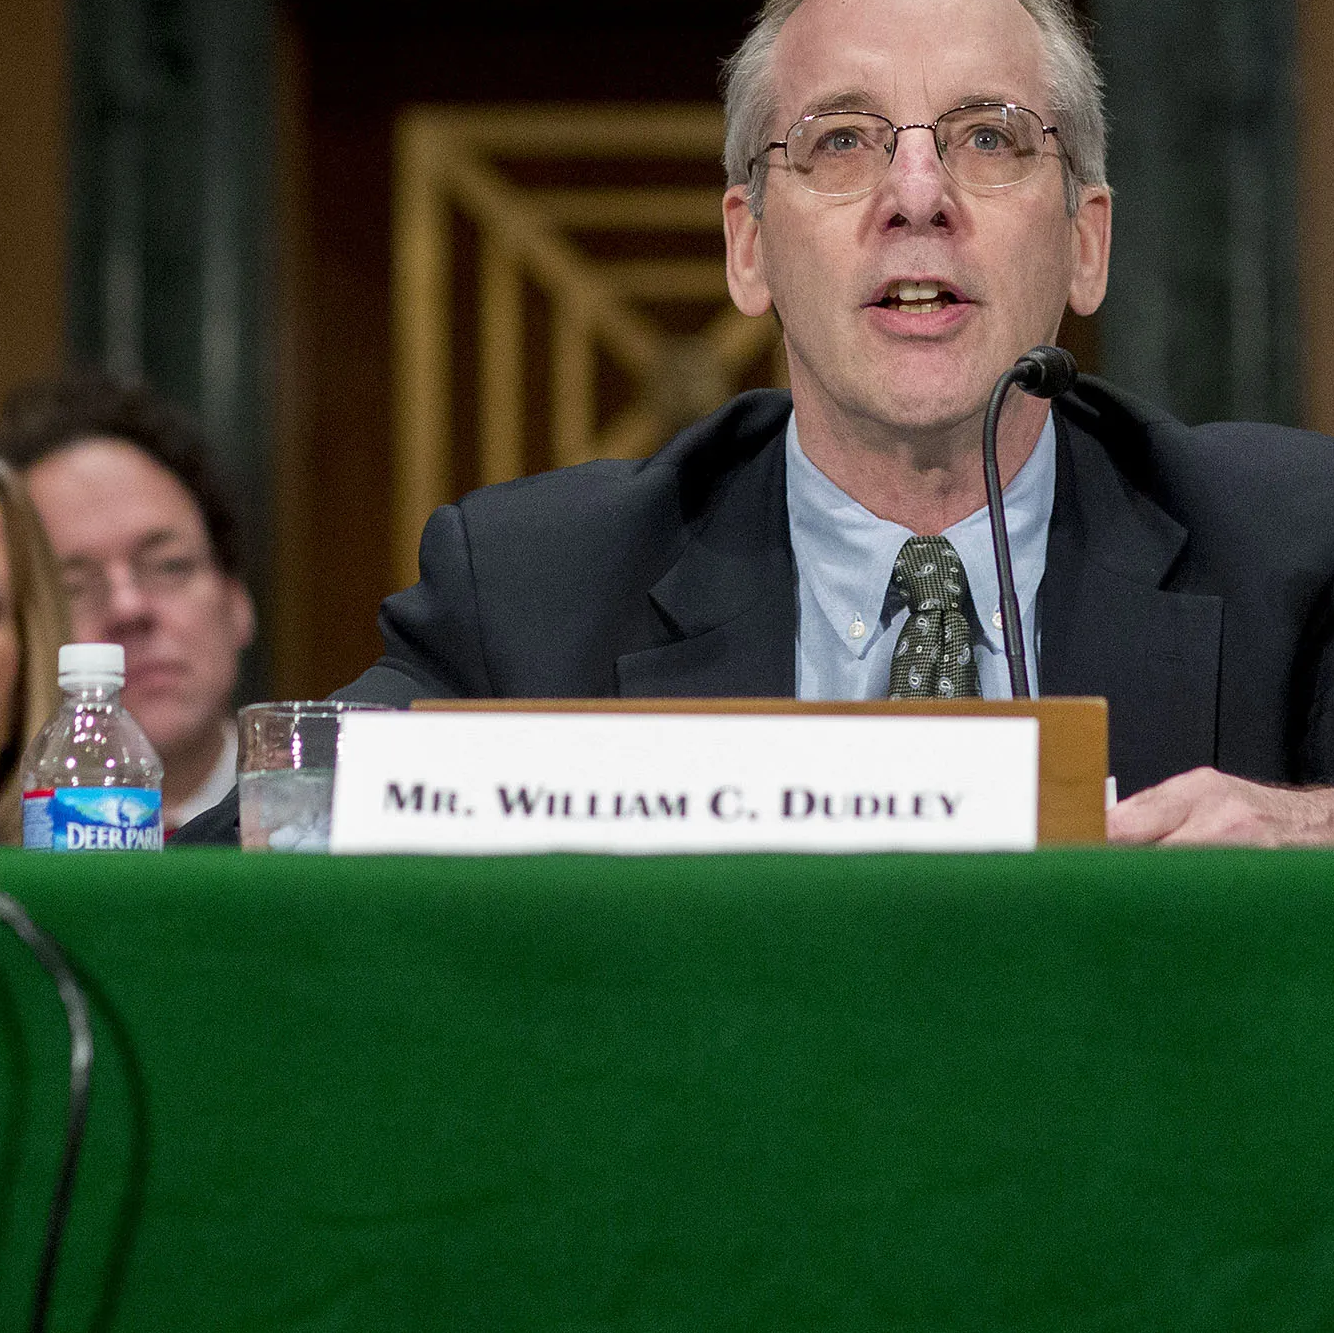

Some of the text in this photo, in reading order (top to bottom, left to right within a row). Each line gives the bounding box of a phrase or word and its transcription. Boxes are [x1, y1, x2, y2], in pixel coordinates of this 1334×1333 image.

[496, 782, 688, 818] WILLIAM
[709, 785, 757, 820] C.
[780, 789, 961, 819] DUDLEY
[67, 821, 124, 850] DEER
